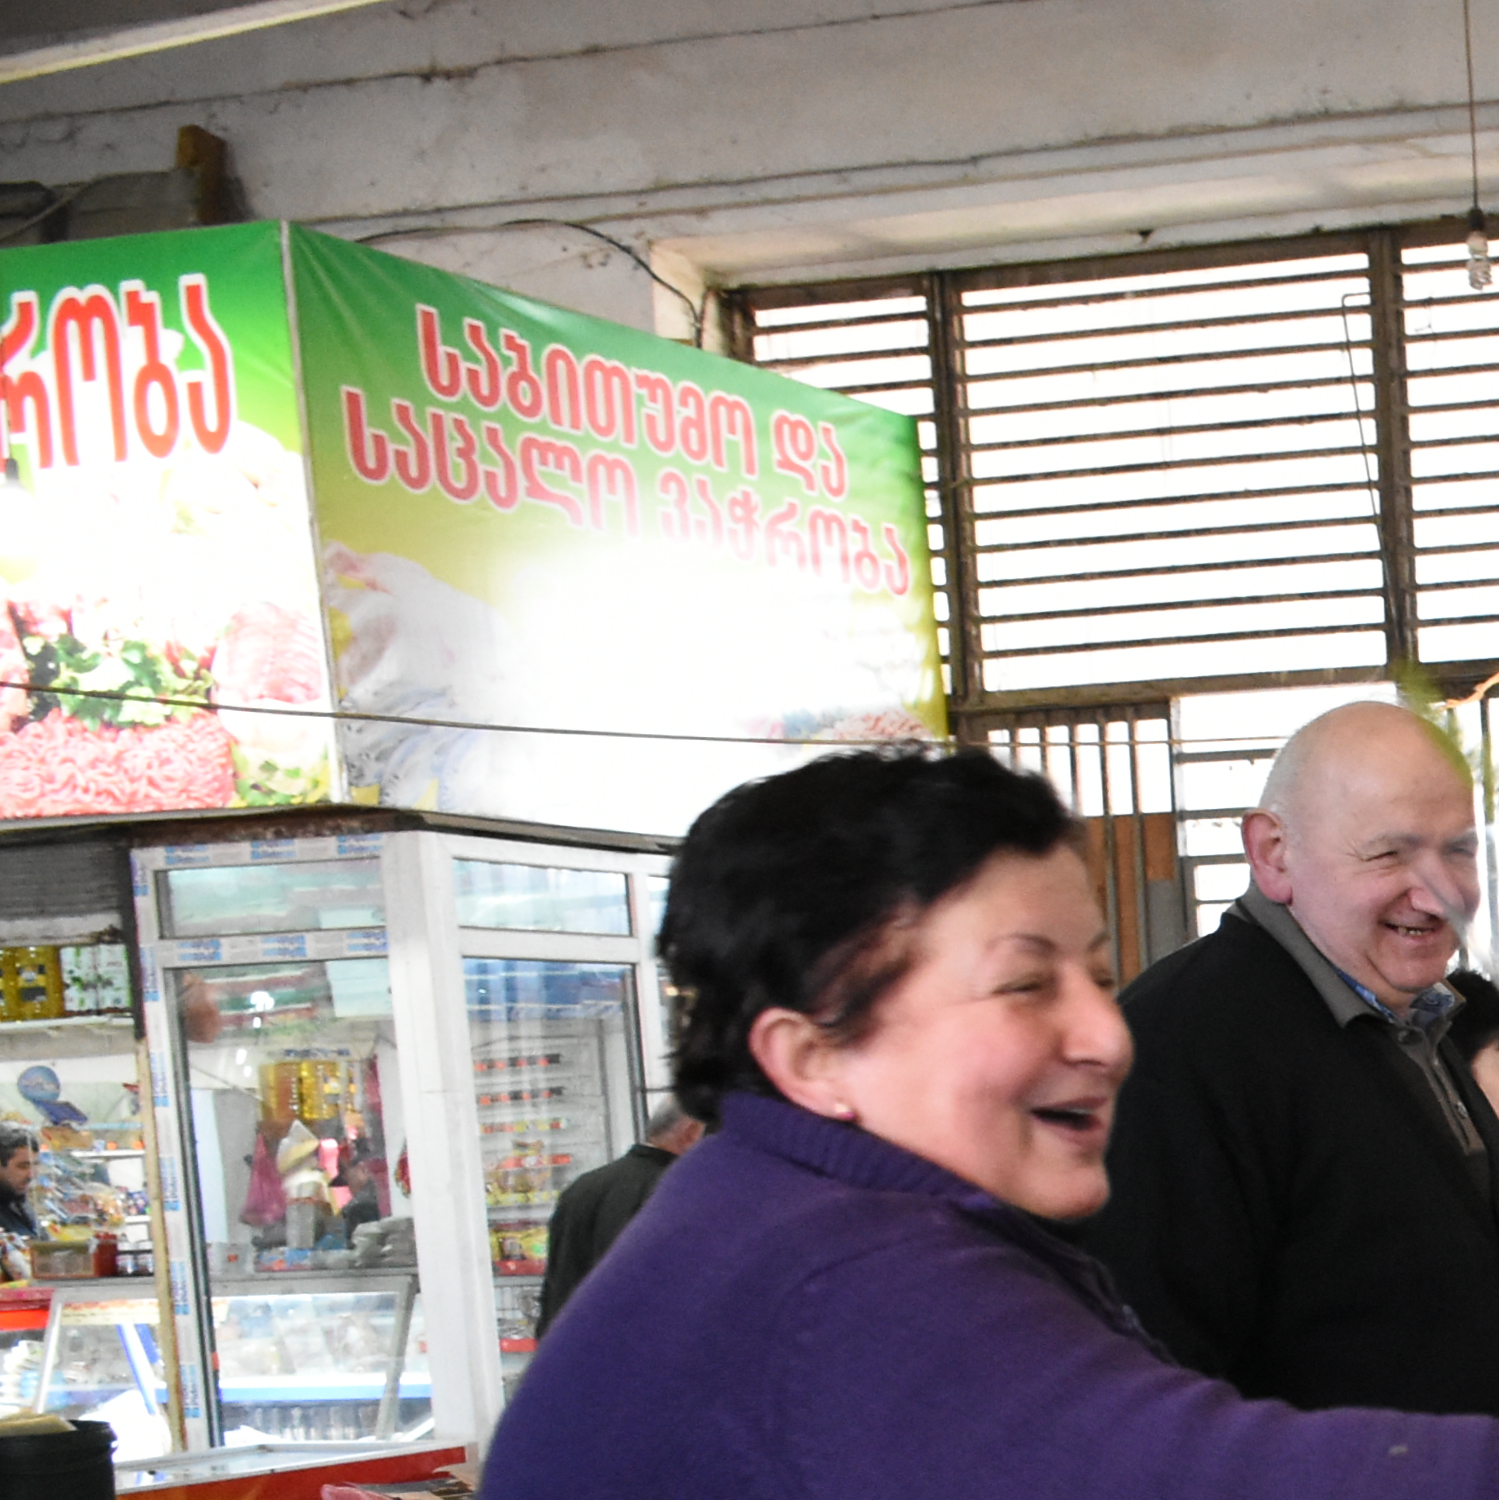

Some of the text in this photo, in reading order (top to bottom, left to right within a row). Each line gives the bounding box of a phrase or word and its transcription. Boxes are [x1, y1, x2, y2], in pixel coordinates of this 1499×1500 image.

[342, 385, 909, 596] საცალო ვაჭრობა
[417, 304, 847, 499] საბითუმო და
